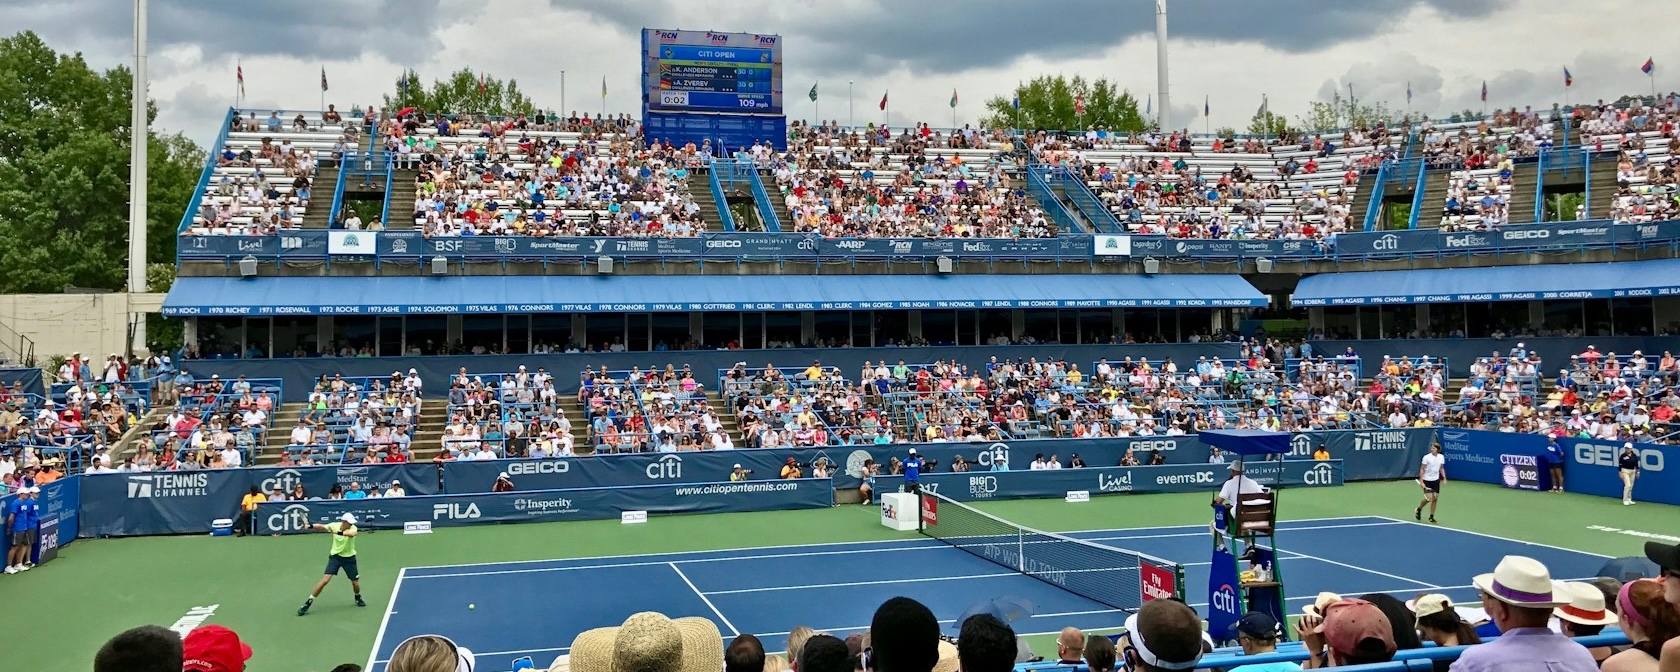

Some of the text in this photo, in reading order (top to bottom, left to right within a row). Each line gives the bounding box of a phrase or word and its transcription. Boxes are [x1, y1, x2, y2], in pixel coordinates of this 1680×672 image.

[1504, 230, 1549, 239] GEICO
[238, 239, 263, 251] Live!
[435, 240, 463, 251] BSF
[797, 238, 814, 250] citi
[963, 242, 991, 252] FedEx
[1373, 234, 1397, 249] citi
[1446, 235, 1486, 247] FedEx
[1371, 431, 1406, 443] TENNIS
[1129, 440, 1176, 452] GEICO
[1444, 441, 1468, 451] MedStar
[978, 442, 1009, 466] citi
[1445, 452, 1494, 464] Sports Medicine
[1500, 454, 1537, 466] CITIZEN
[508, 461, 569, 474] GEICO
[646, 454, 682, 478] citi
[1156, 471, 1214, 485] eventsDC
[1304, 462, 1332, 485] citi
[1519, 470, 1538, 480] 0:02
[155, 473, 208, 489] TENNIS
[970, 477, 984, 485] BIG
[1099, 470, 1132, 491] Live!
[155, 487, 208, 497] CHANNEL
[676, 482, 798, 496] www.citiopentennis.com
[970, 485, 985, 494] BUS
[527, 498, 572, 510] Insperity
[433, 502, 481, 520] FILA
[984, 546, 1066, 586] ATP WOLD TOUR
[1151, 573, 1161, 587] Fly
[1143, 580, 1172, 599] Emirates
[1213, 584, 1234, 614] citi
